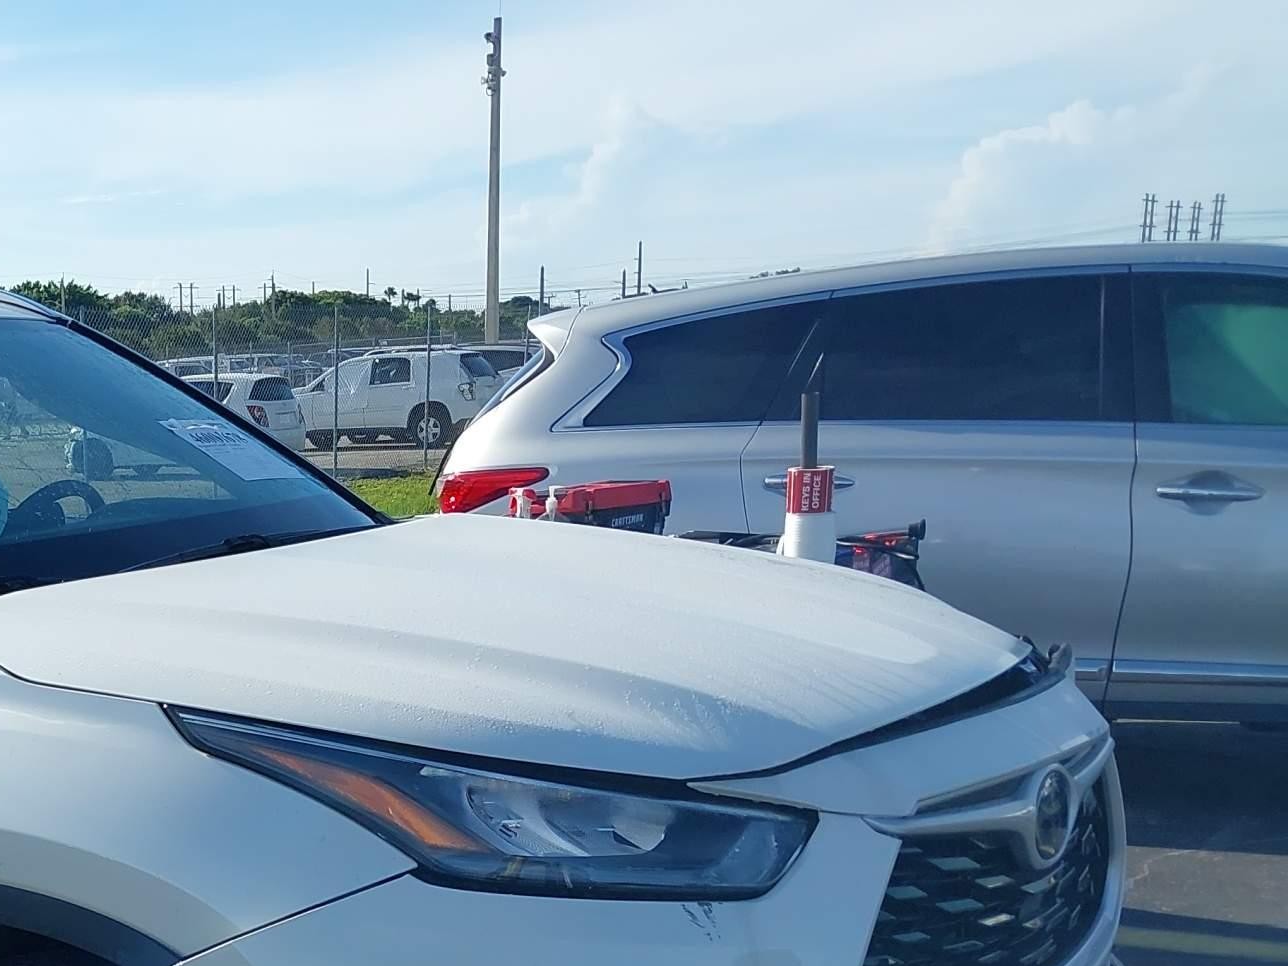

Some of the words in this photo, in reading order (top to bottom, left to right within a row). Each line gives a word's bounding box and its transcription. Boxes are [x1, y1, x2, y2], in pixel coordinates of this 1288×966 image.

[803, 472, 811, 483] IN
[801, 486, 811, 511] KEYS
[811, 474, 822, 509] OFFICE
